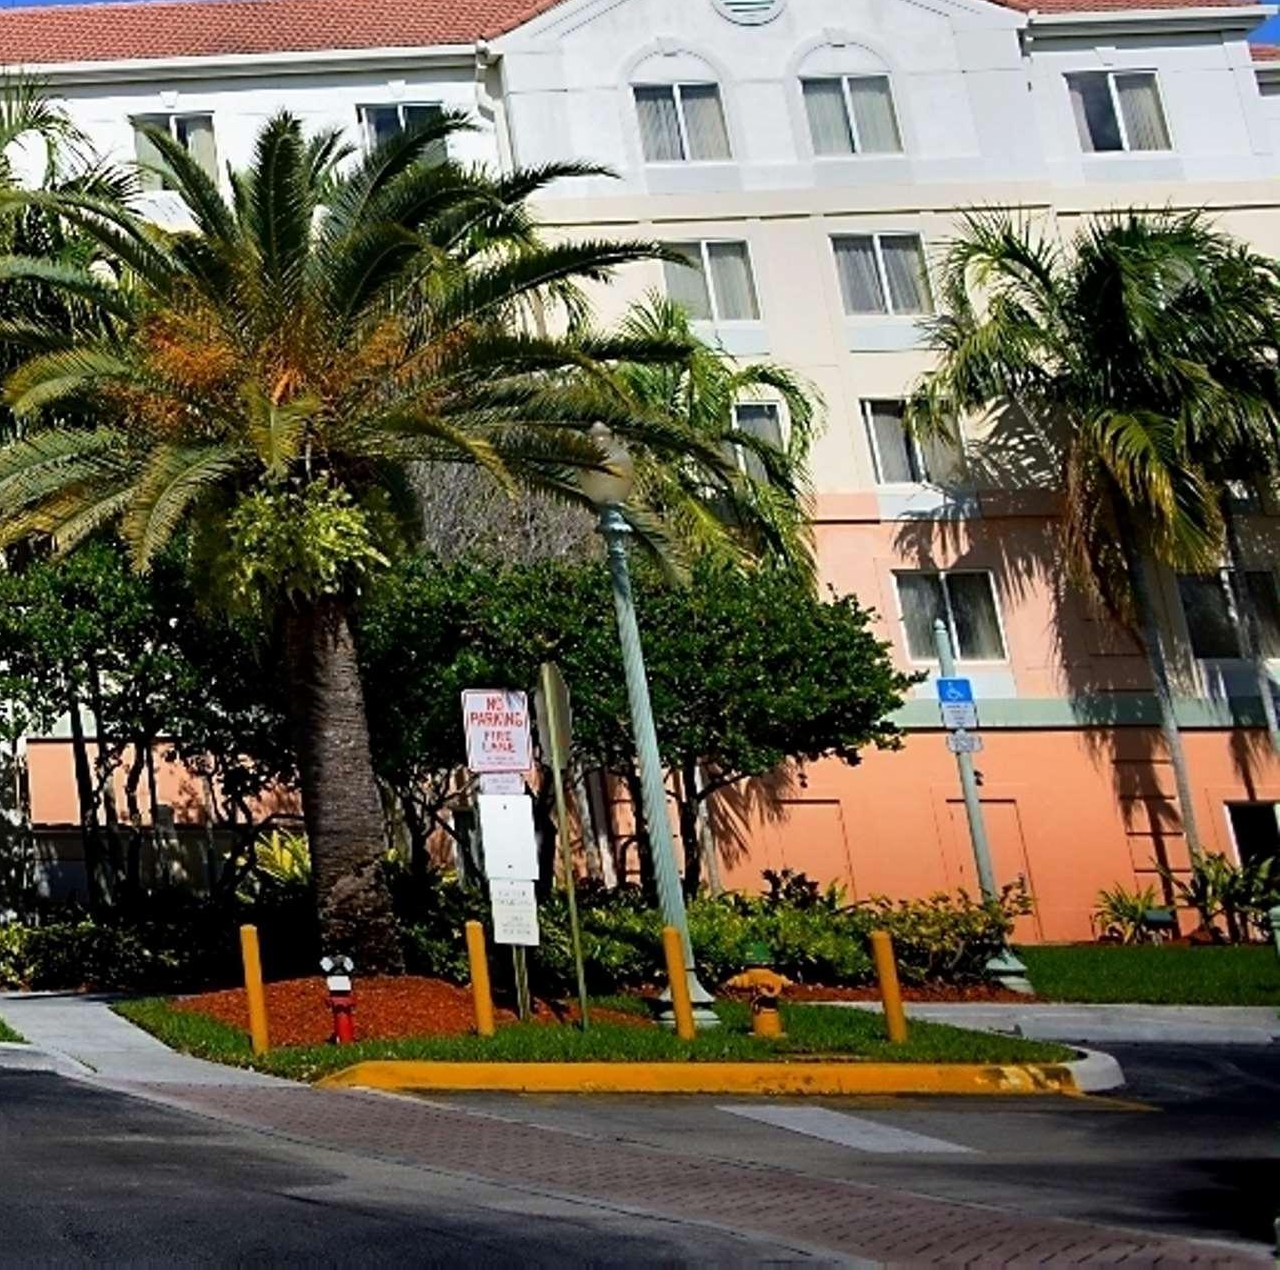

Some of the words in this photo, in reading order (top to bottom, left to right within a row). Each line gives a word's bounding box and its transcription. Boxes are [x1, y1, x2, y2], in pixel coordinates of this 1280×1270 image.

[486, 697, 504, 711] NO
[470, 711, 523, 728] PARKING
[484, 730, 512, 742] FIRE
[482, 741, 516, 753] LANE
